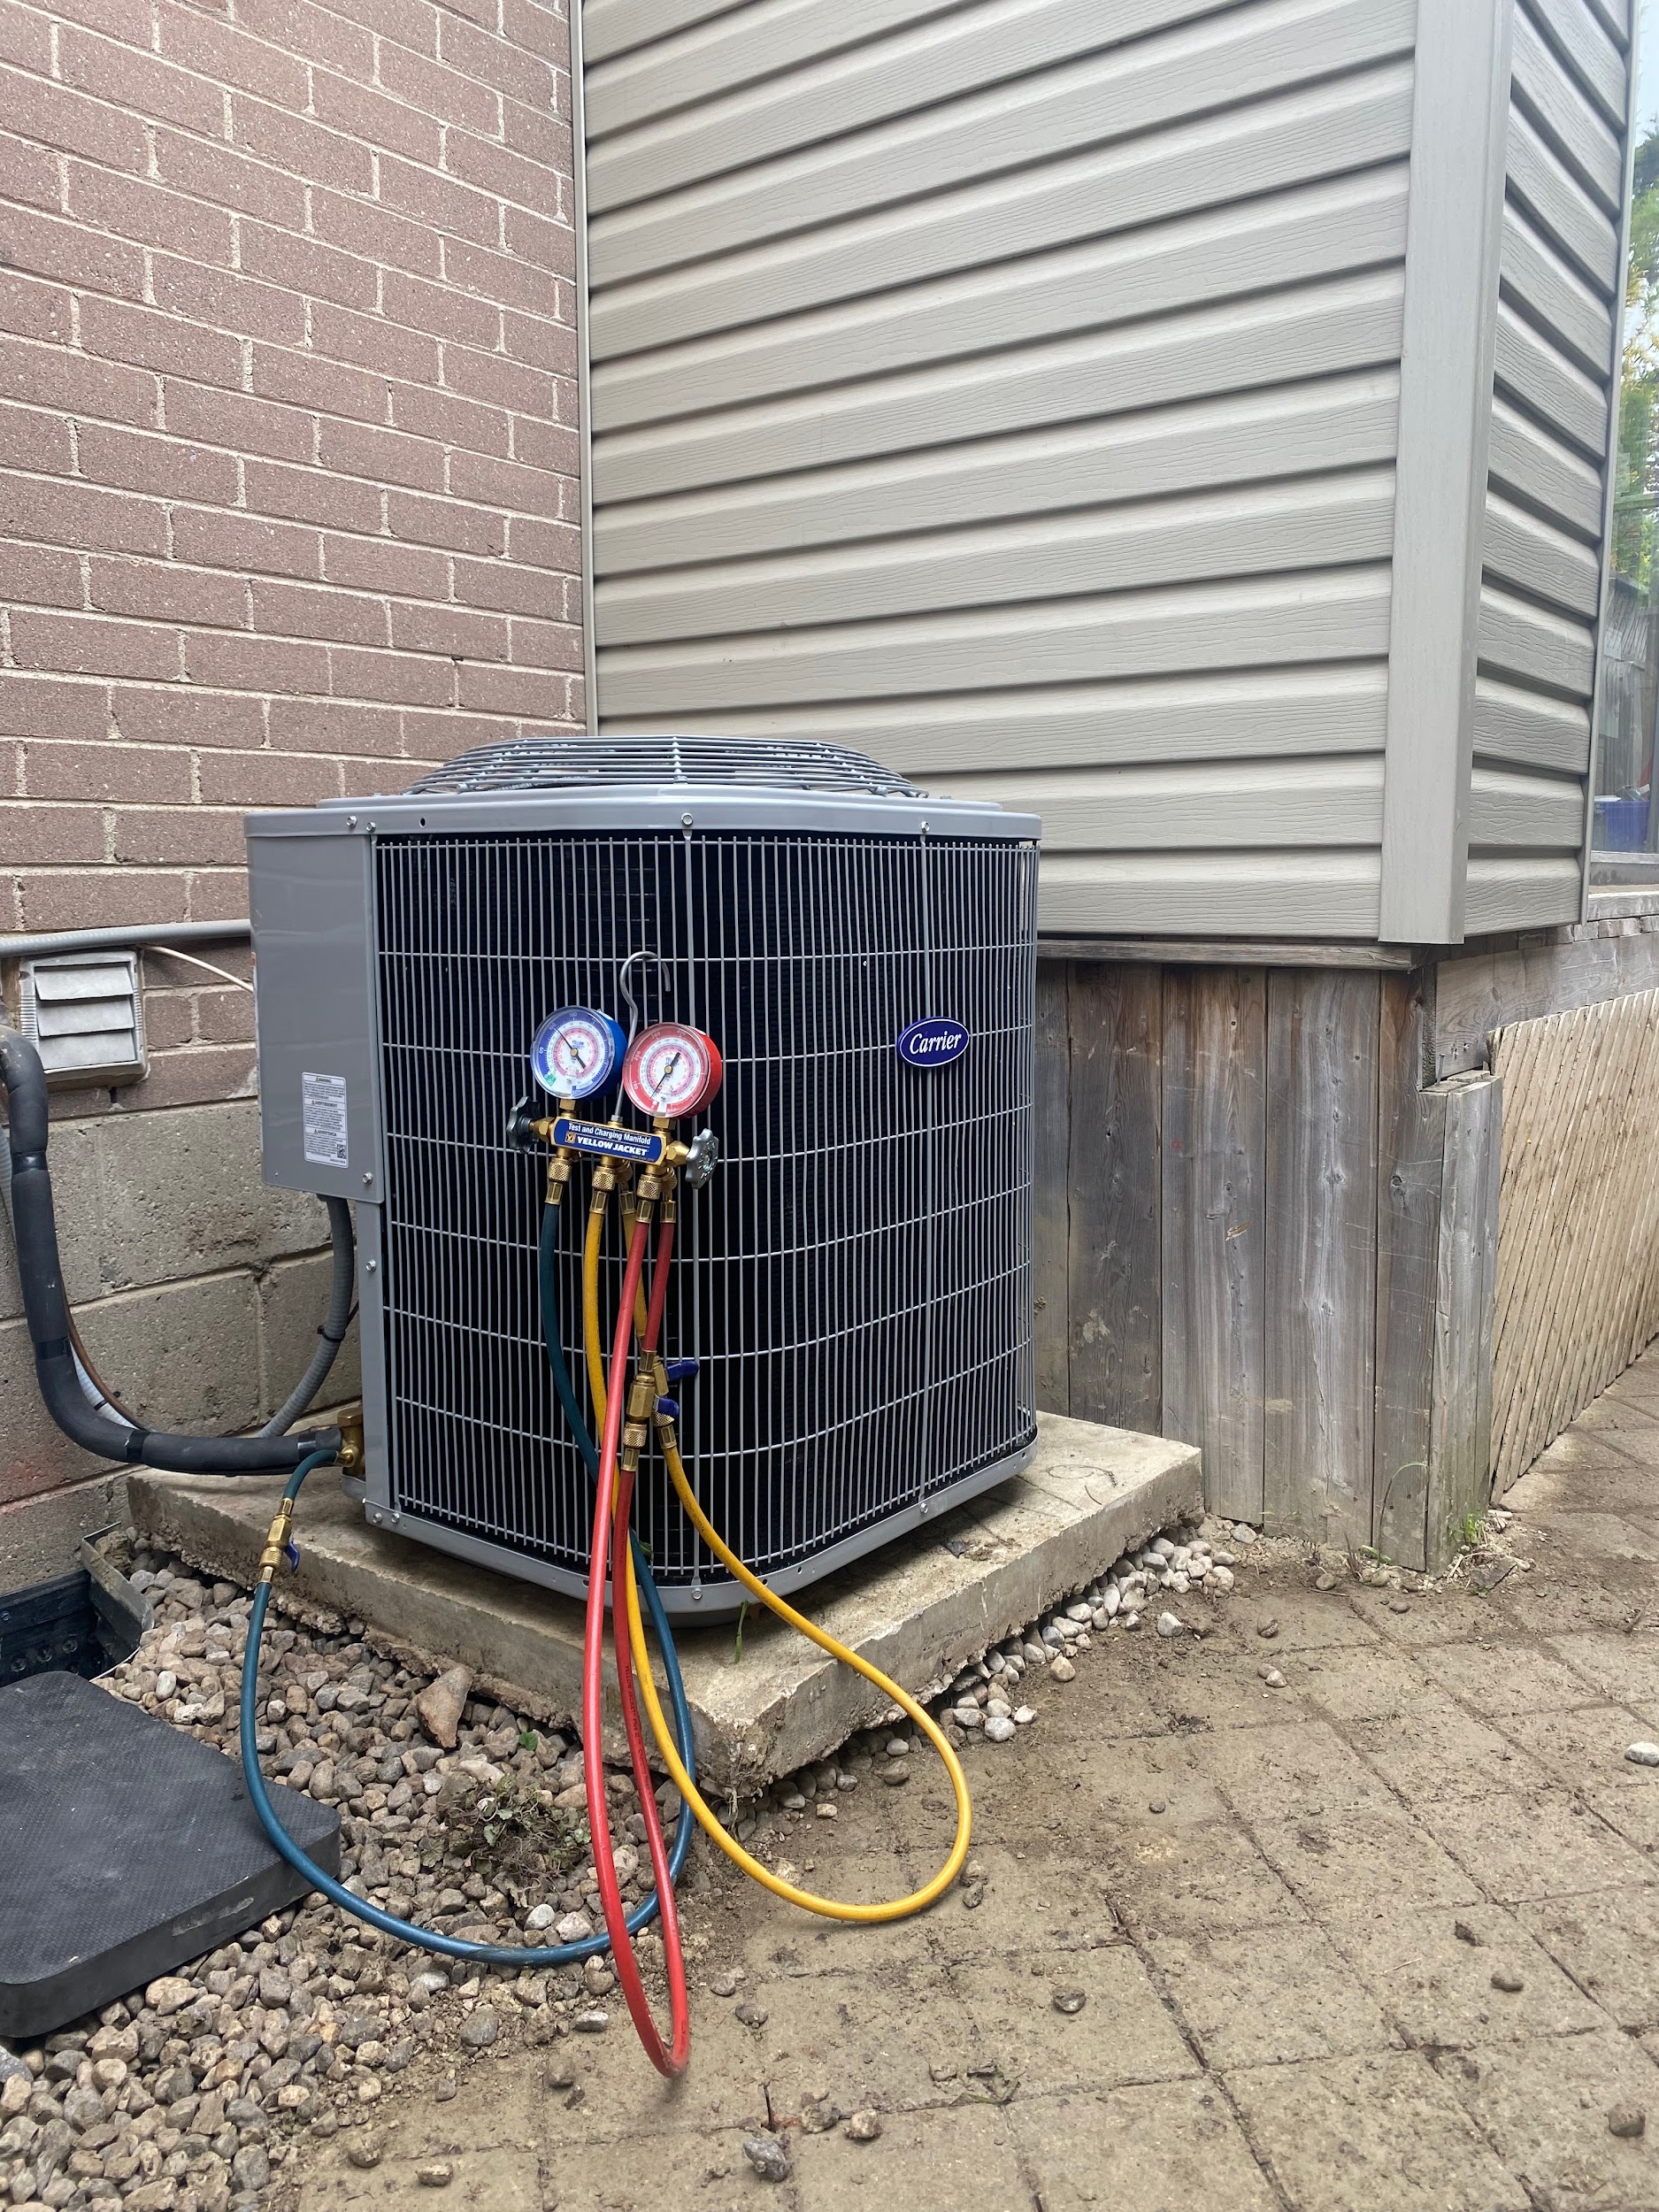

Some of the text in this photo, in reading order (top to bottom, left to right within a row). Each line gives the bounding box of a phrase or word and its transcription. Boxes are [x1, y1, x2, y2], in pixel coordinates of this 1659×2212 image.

[910, 1030, 962, 1055] Carrier
[568, 1122, 581, 1132] Test
[595, 1128, 622, 1141] Charging
[623, 1133, 651, 1145] Manifold
[577, 1136, 648, 1156] YELLOW JACKET
